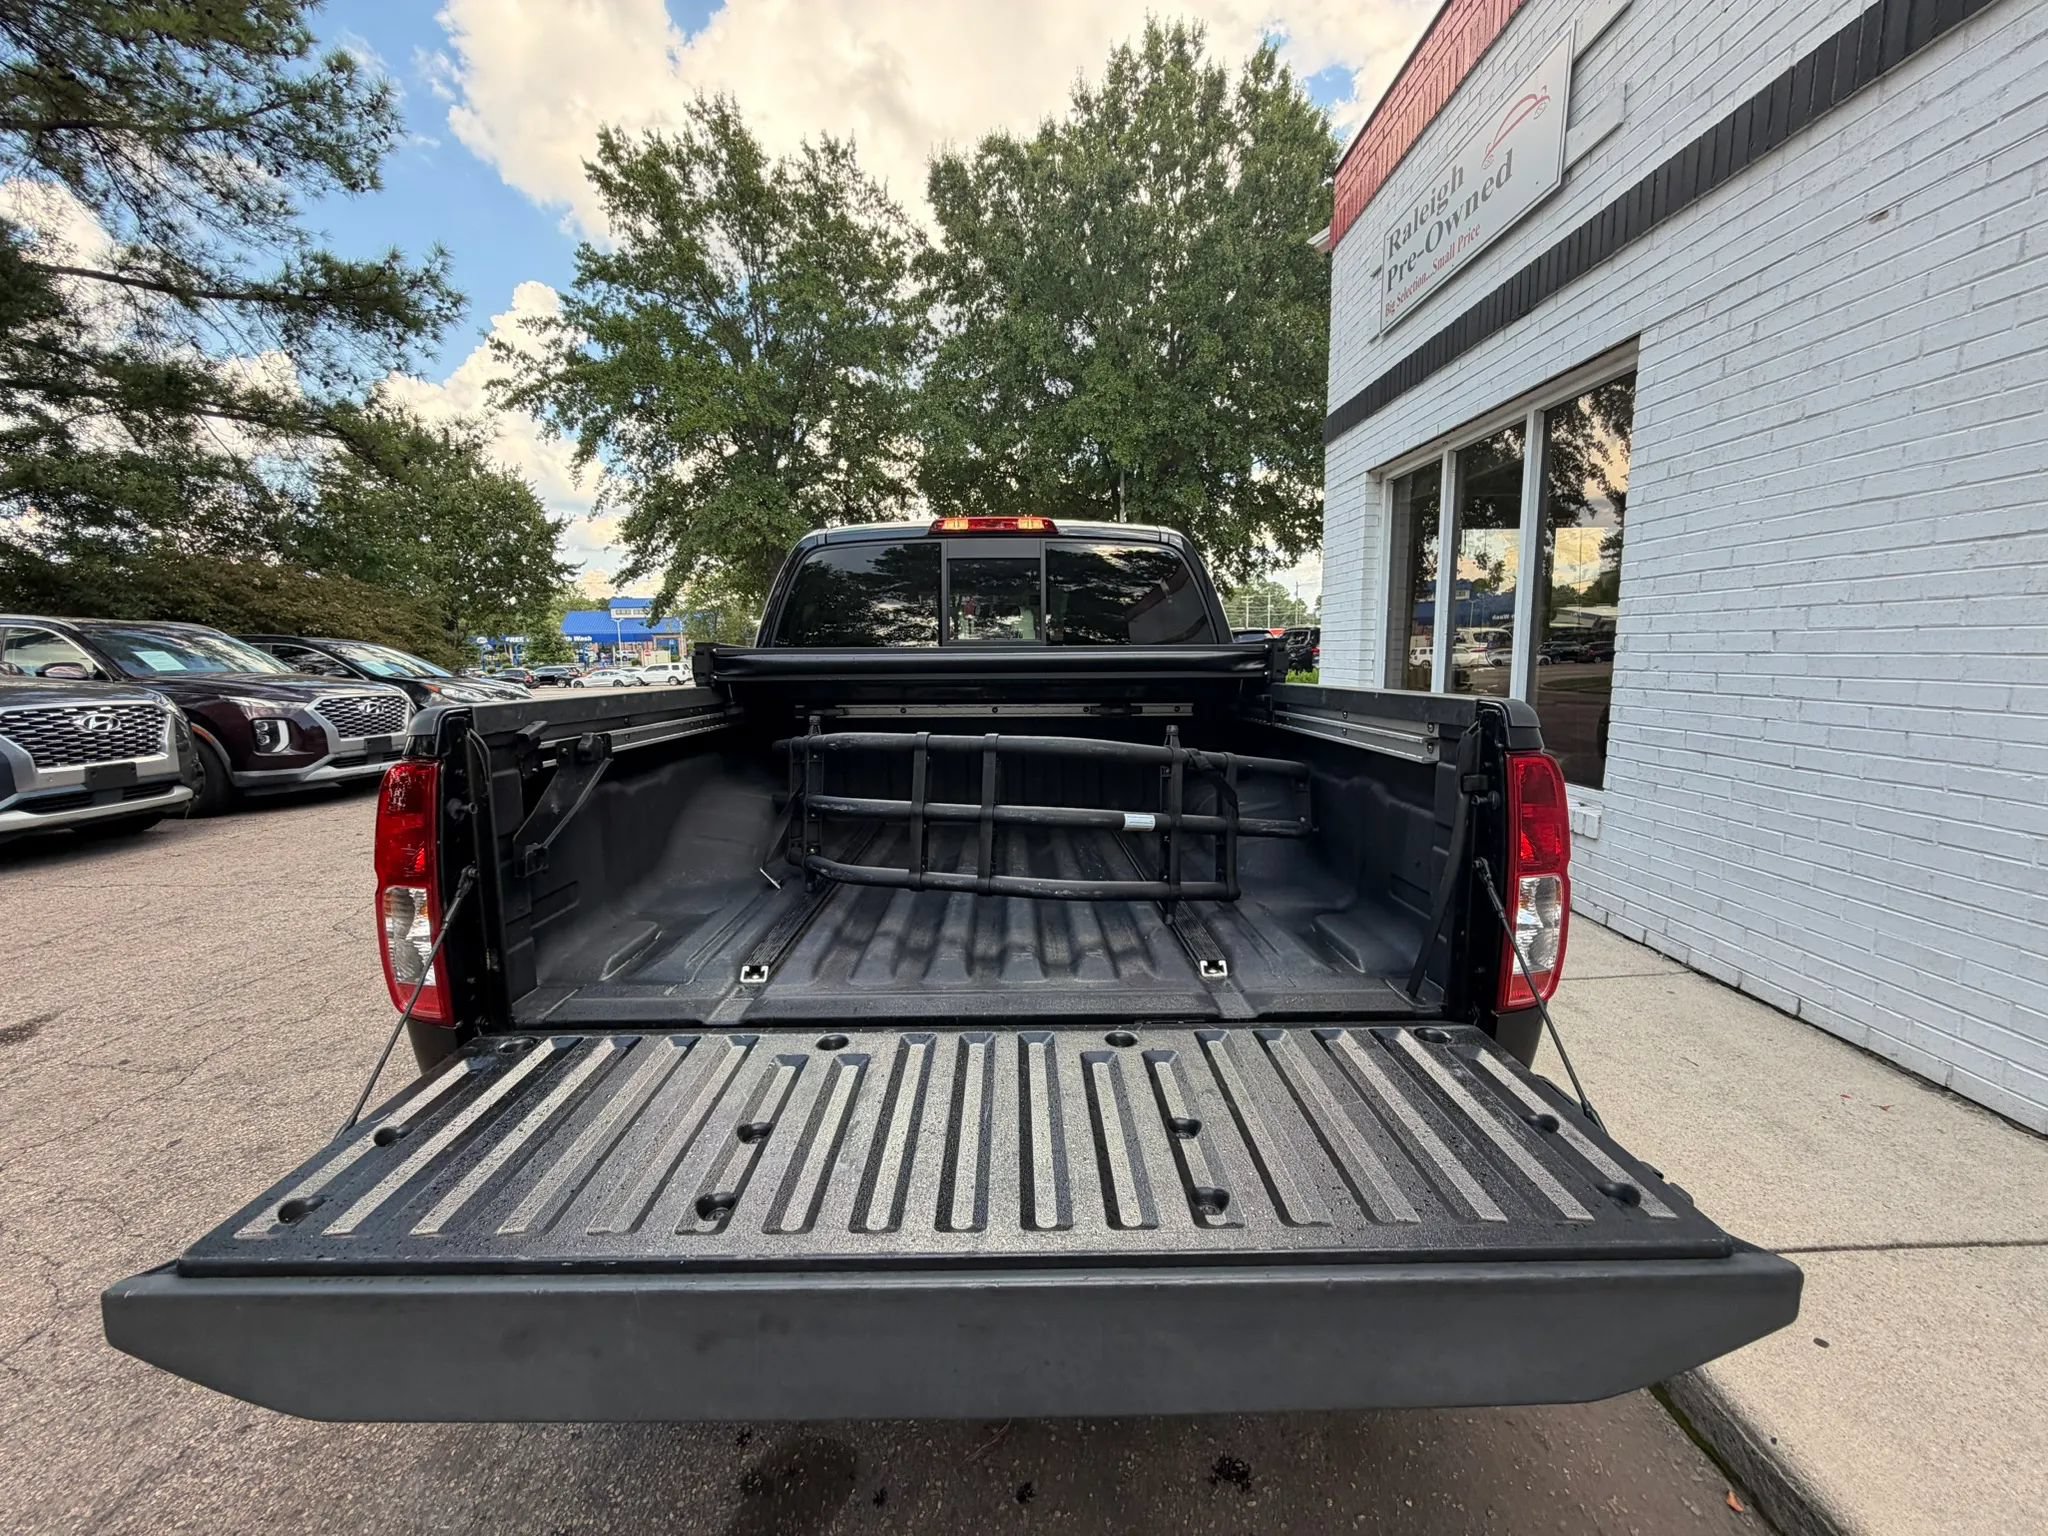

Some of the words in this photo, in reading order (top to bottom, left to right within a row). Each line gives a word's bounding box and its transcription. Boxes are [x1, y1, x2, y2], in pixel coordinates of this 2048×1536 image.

[1387, 164, 1464, 261] Raleigh
[1387, 148, 1513, 295] Pre-Owned
[1385, 299, 1397, 318] Big
[1457, 223, 1481, 253] Price
